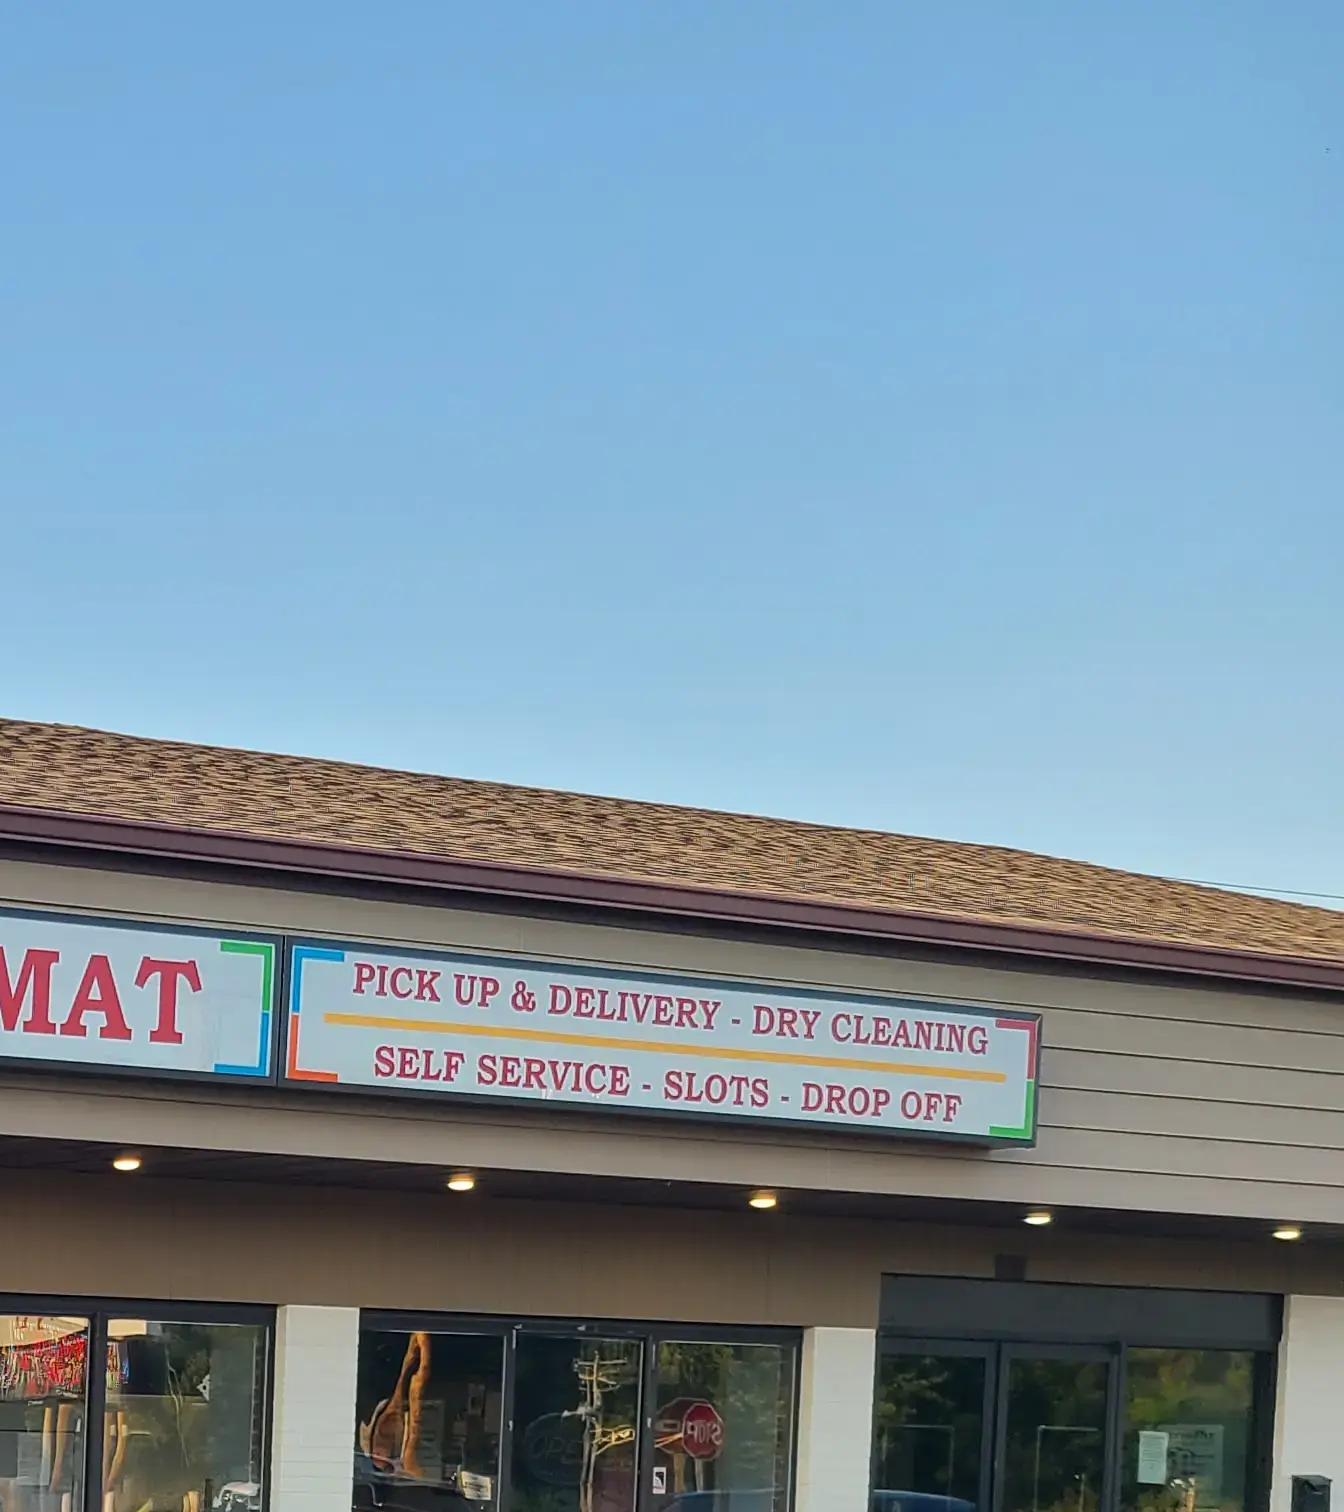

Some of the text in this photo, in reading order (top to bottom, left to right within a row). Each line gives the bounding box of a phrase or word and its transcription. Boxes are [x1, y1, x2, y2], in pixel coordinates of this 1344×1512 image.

[353, 963, 441, 1003] PICK
[453, 973, 500, 1008] UP
[511, 980, 536, 1012] &
[547, 984, 721, 1029] DELIVERY
[752, 1005, 821, 1039] DRY
[831, 1013, 989, 1055] CLEANING
[374, 1046, 465, 1083] SELF
[477, 1054, 629, 1096] SERVICE
[664, 1070, 769, 1108] SLOTS
[801, 1083, 890, 1118] DROP
[901, 1092, 962, 1122] OFF
